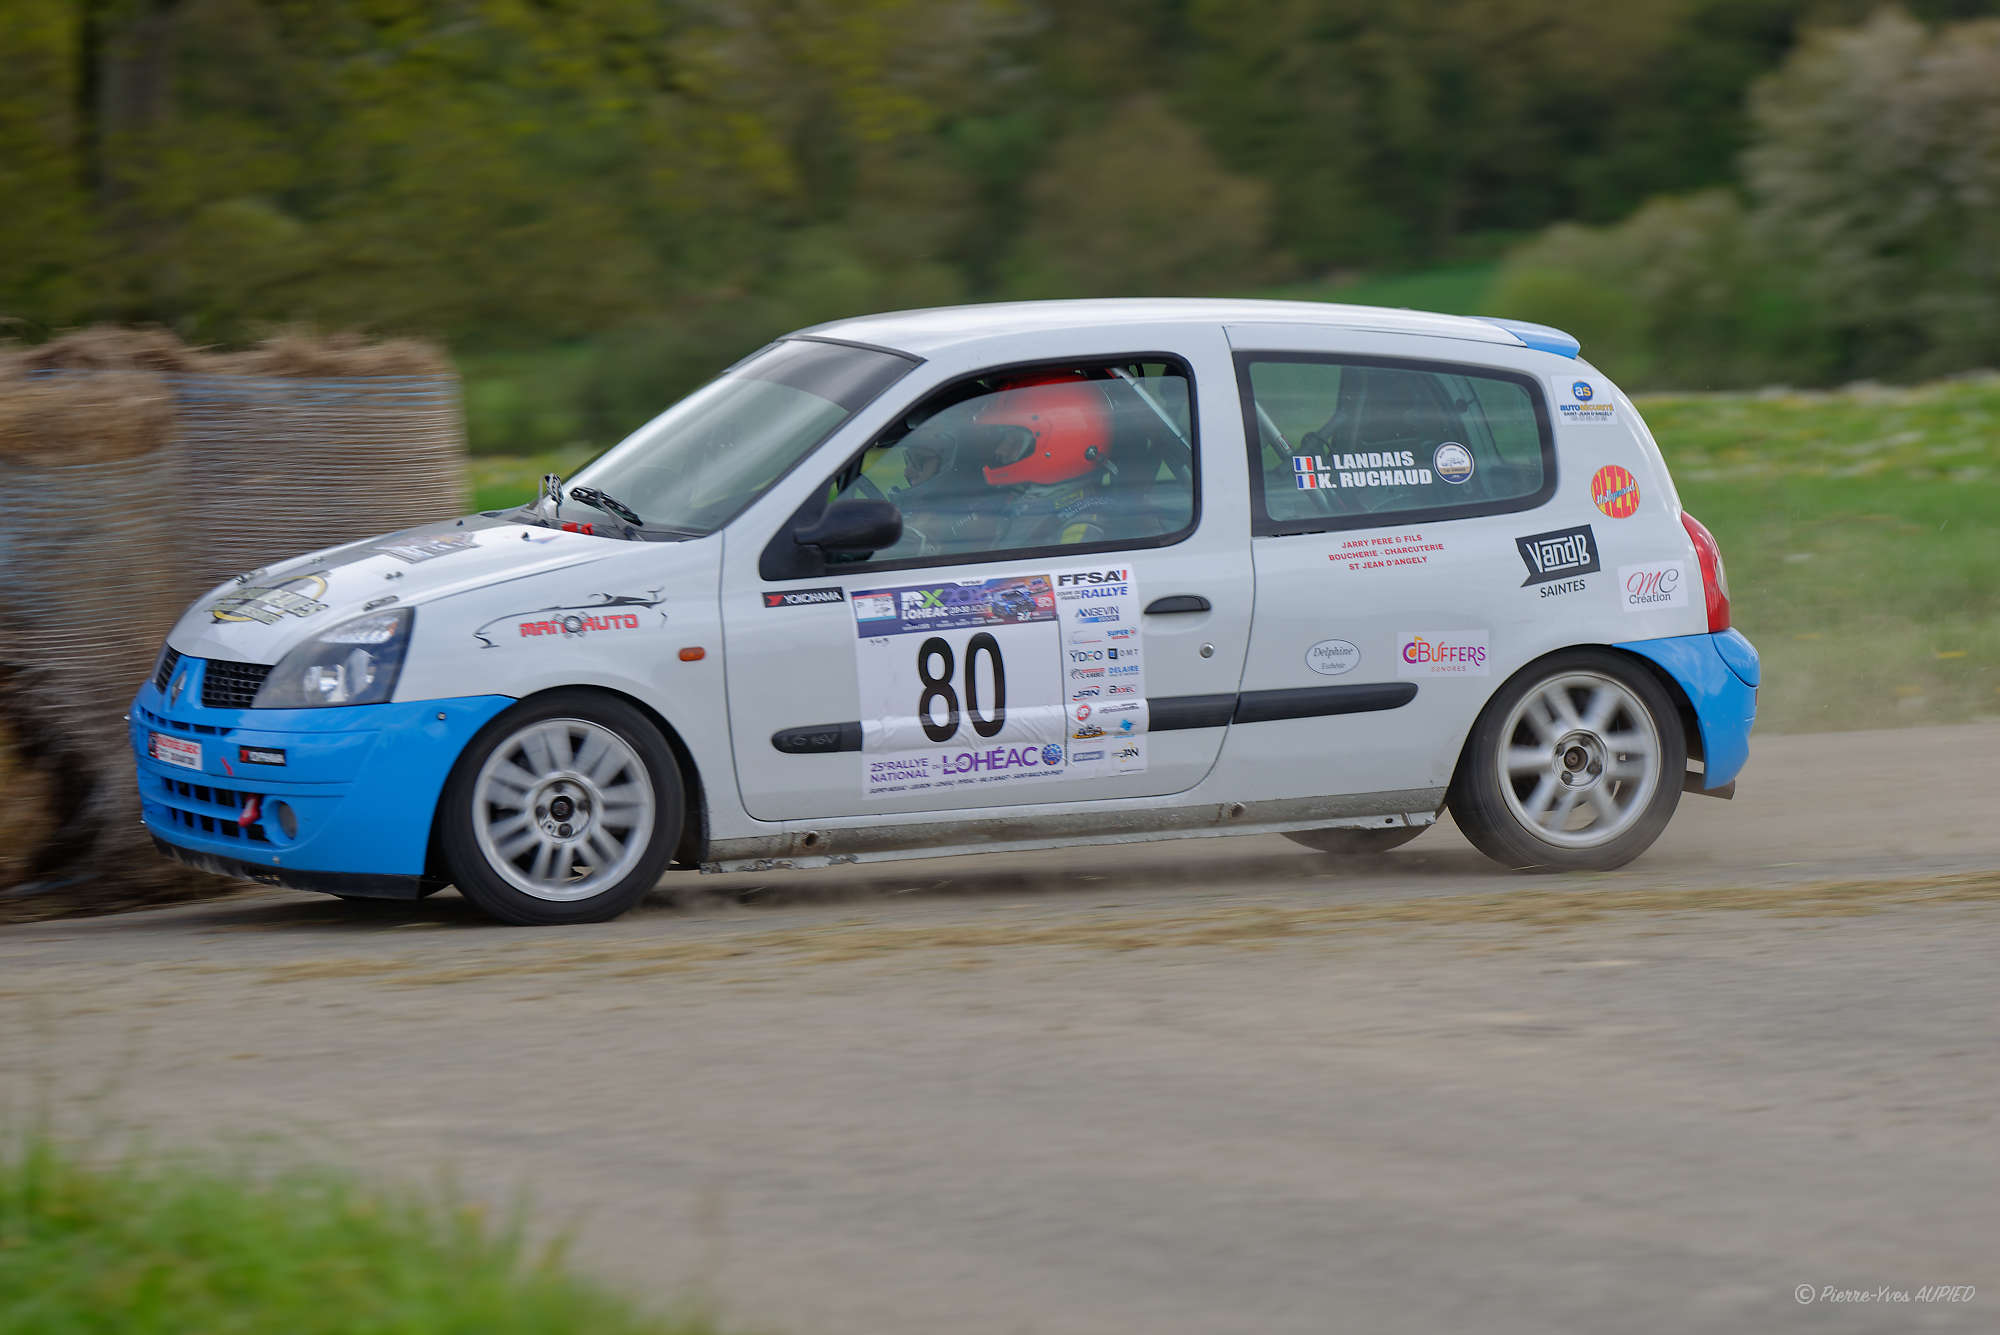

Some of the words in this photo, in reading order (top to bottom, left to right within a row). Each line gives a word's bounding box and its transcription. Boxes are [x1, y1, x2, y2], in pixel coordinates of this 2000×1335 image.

[1315, 456, 1331, 471] L.
[1334, 451, 1415, 470] LANDAIS
[1316, 473, 1337, 489] K.
[1341, 469, 1433, 488] RUCHAUD
[1342, 539, 1368, 549] JARRY
[1371, 537, 1393, 546] PERE
[1404, 534, 1423, 543] FILS
[1328, 549, 1378, 561] BOUCHERIE
[1384, 543, 1444, 556] CHARCUTERIE
[1348, 563, 1360, 571] ST
[1362, 560, 1384, 569] JEAN
[1386, 556, 1428, 567] D'ANGELY
[1058, 570, 1122, 587] FFSA
[1626, 568, 1679, 596] MC
[783, 591, 842, 604] YOKOHAMA
[1081, 586, 1128, 599] RALLYE
[1540, 579, 1586, 599] SAINTES
[1629, 592, 1672, 605] Création
[918, 632, 1006, 743] 80
[887, 758, 929, 770] RALLYE
[943, 746, 1038, 775] LOHÉAC
[871, 769, 930, 783] NATIONAL
